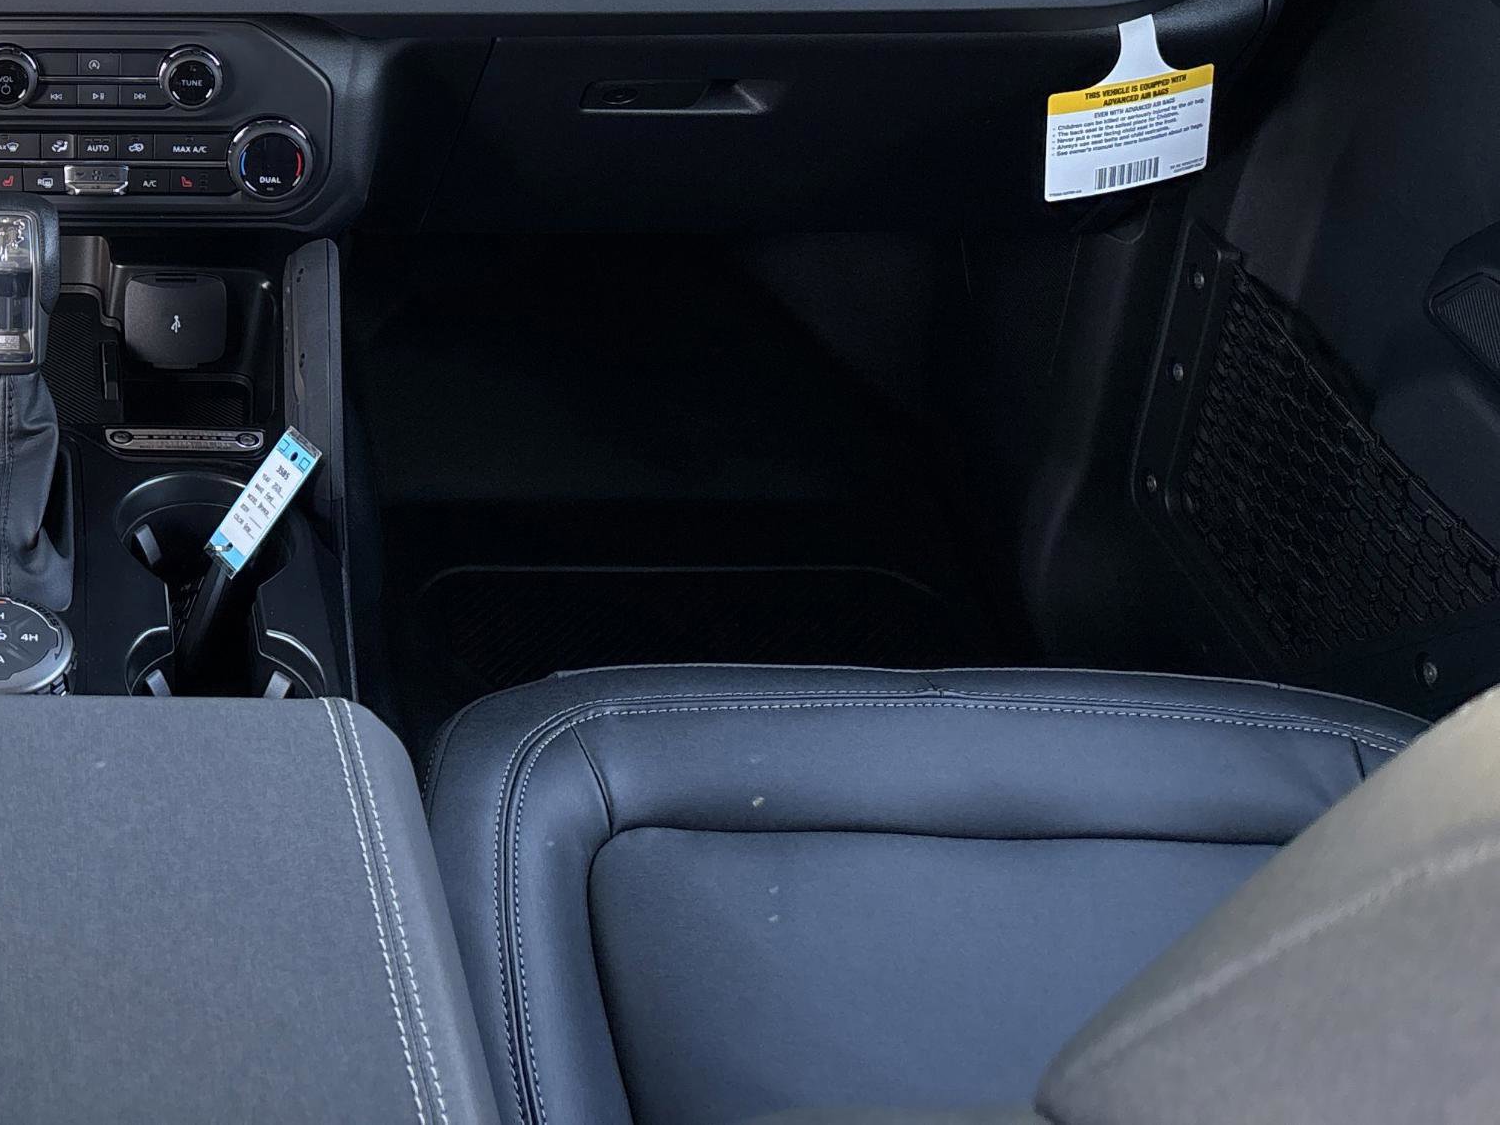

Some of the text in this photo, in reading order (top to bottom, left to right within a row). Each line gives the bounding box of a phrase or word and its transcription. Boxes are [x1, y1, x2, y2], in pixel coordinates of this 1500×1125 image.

[182, 79, 202, 87] TUNE
[1085, 74, 1187, 100] THIS VEHICLE IS EQUIPPED WITH
[1103, 88, 1170, 107] ADVANCED AIR BAGS
[172, 145, 207, 153] MAX A/C
[20, 633, 38, 641] 4H
